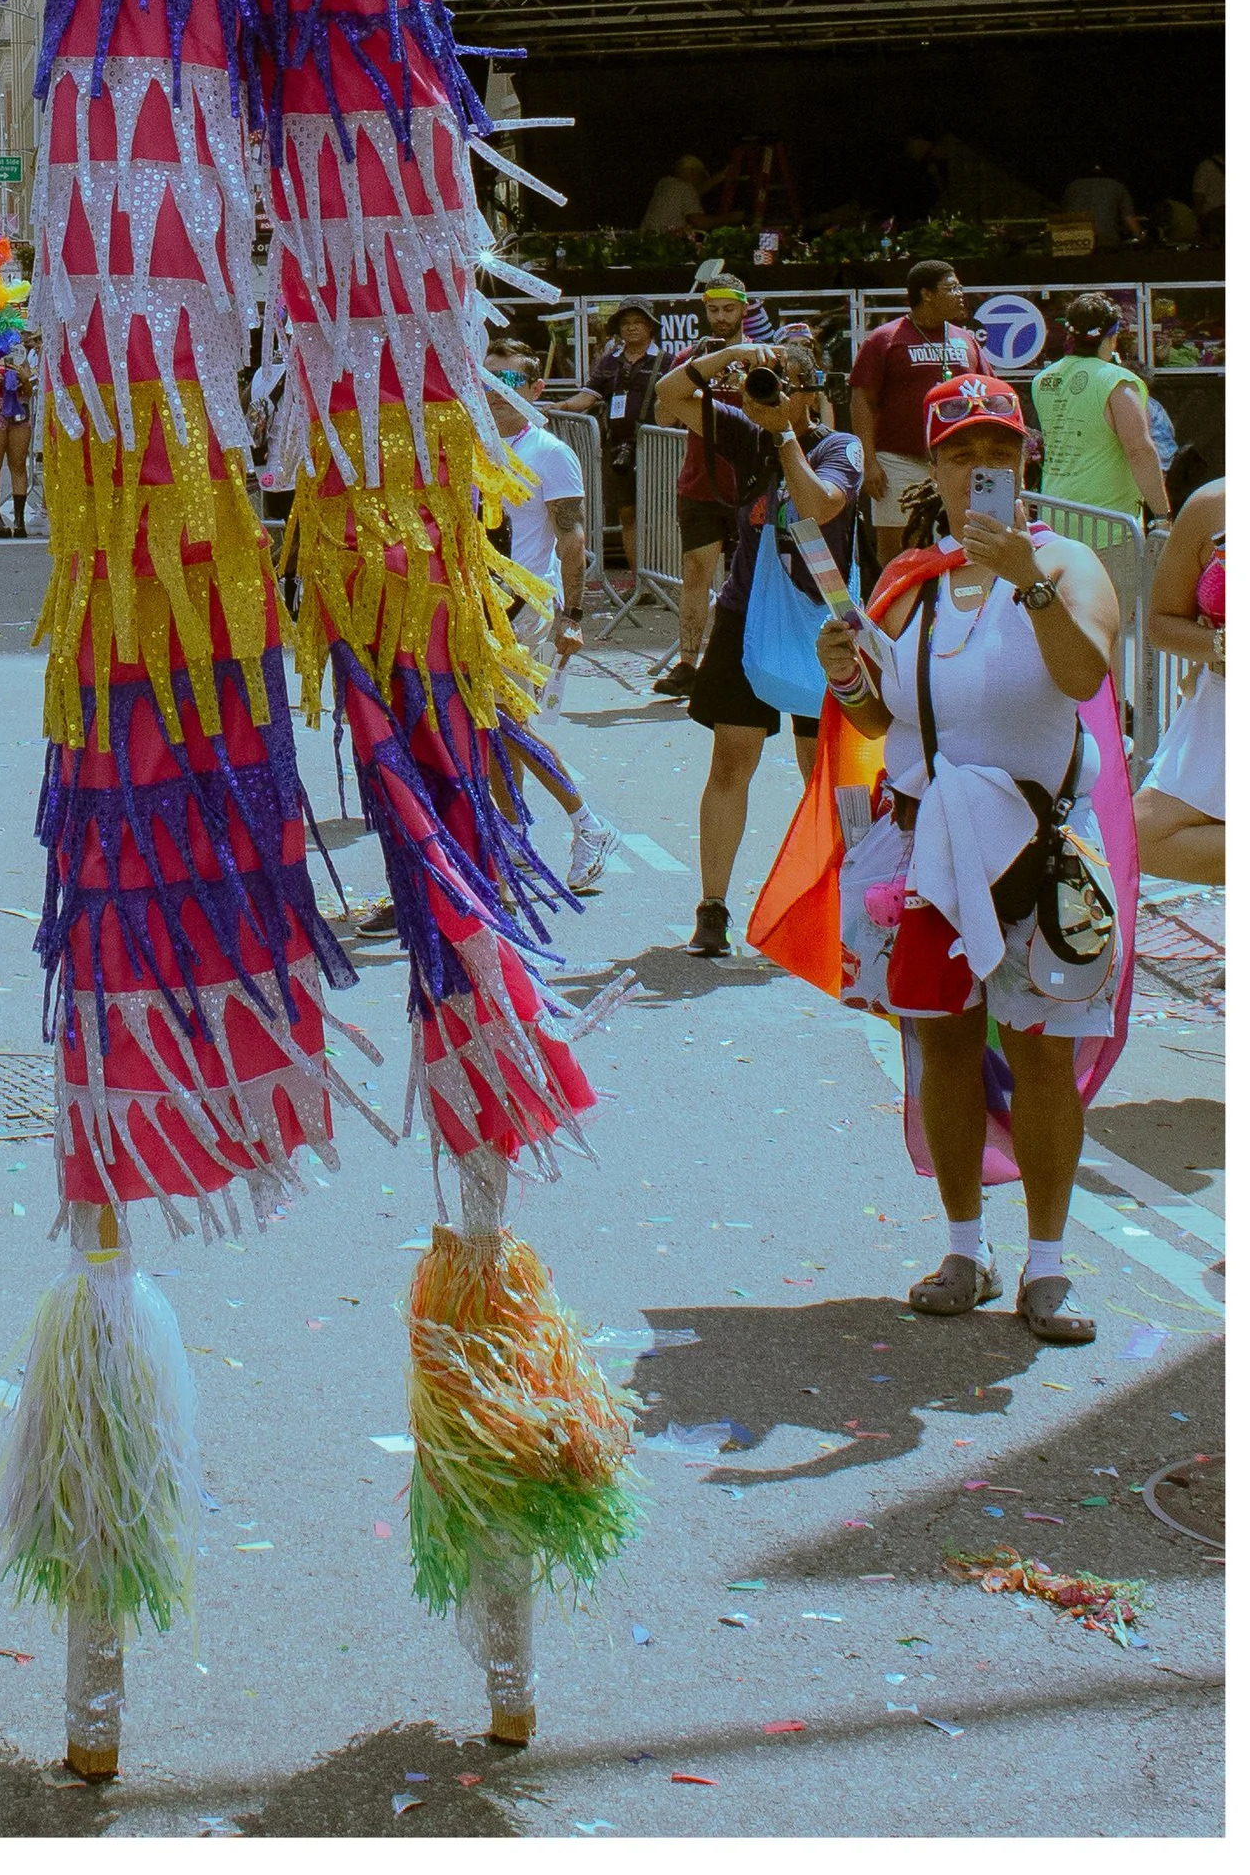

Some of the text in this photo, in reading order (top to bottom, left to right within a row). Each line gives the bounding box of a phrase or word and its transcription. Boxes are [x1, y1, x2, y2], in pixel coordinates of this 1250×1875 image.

[660, 313, 700, 339] NYC
[976, 305, 1040, 365] 7
[908, 347, 968, 363] VOLUNTEER
